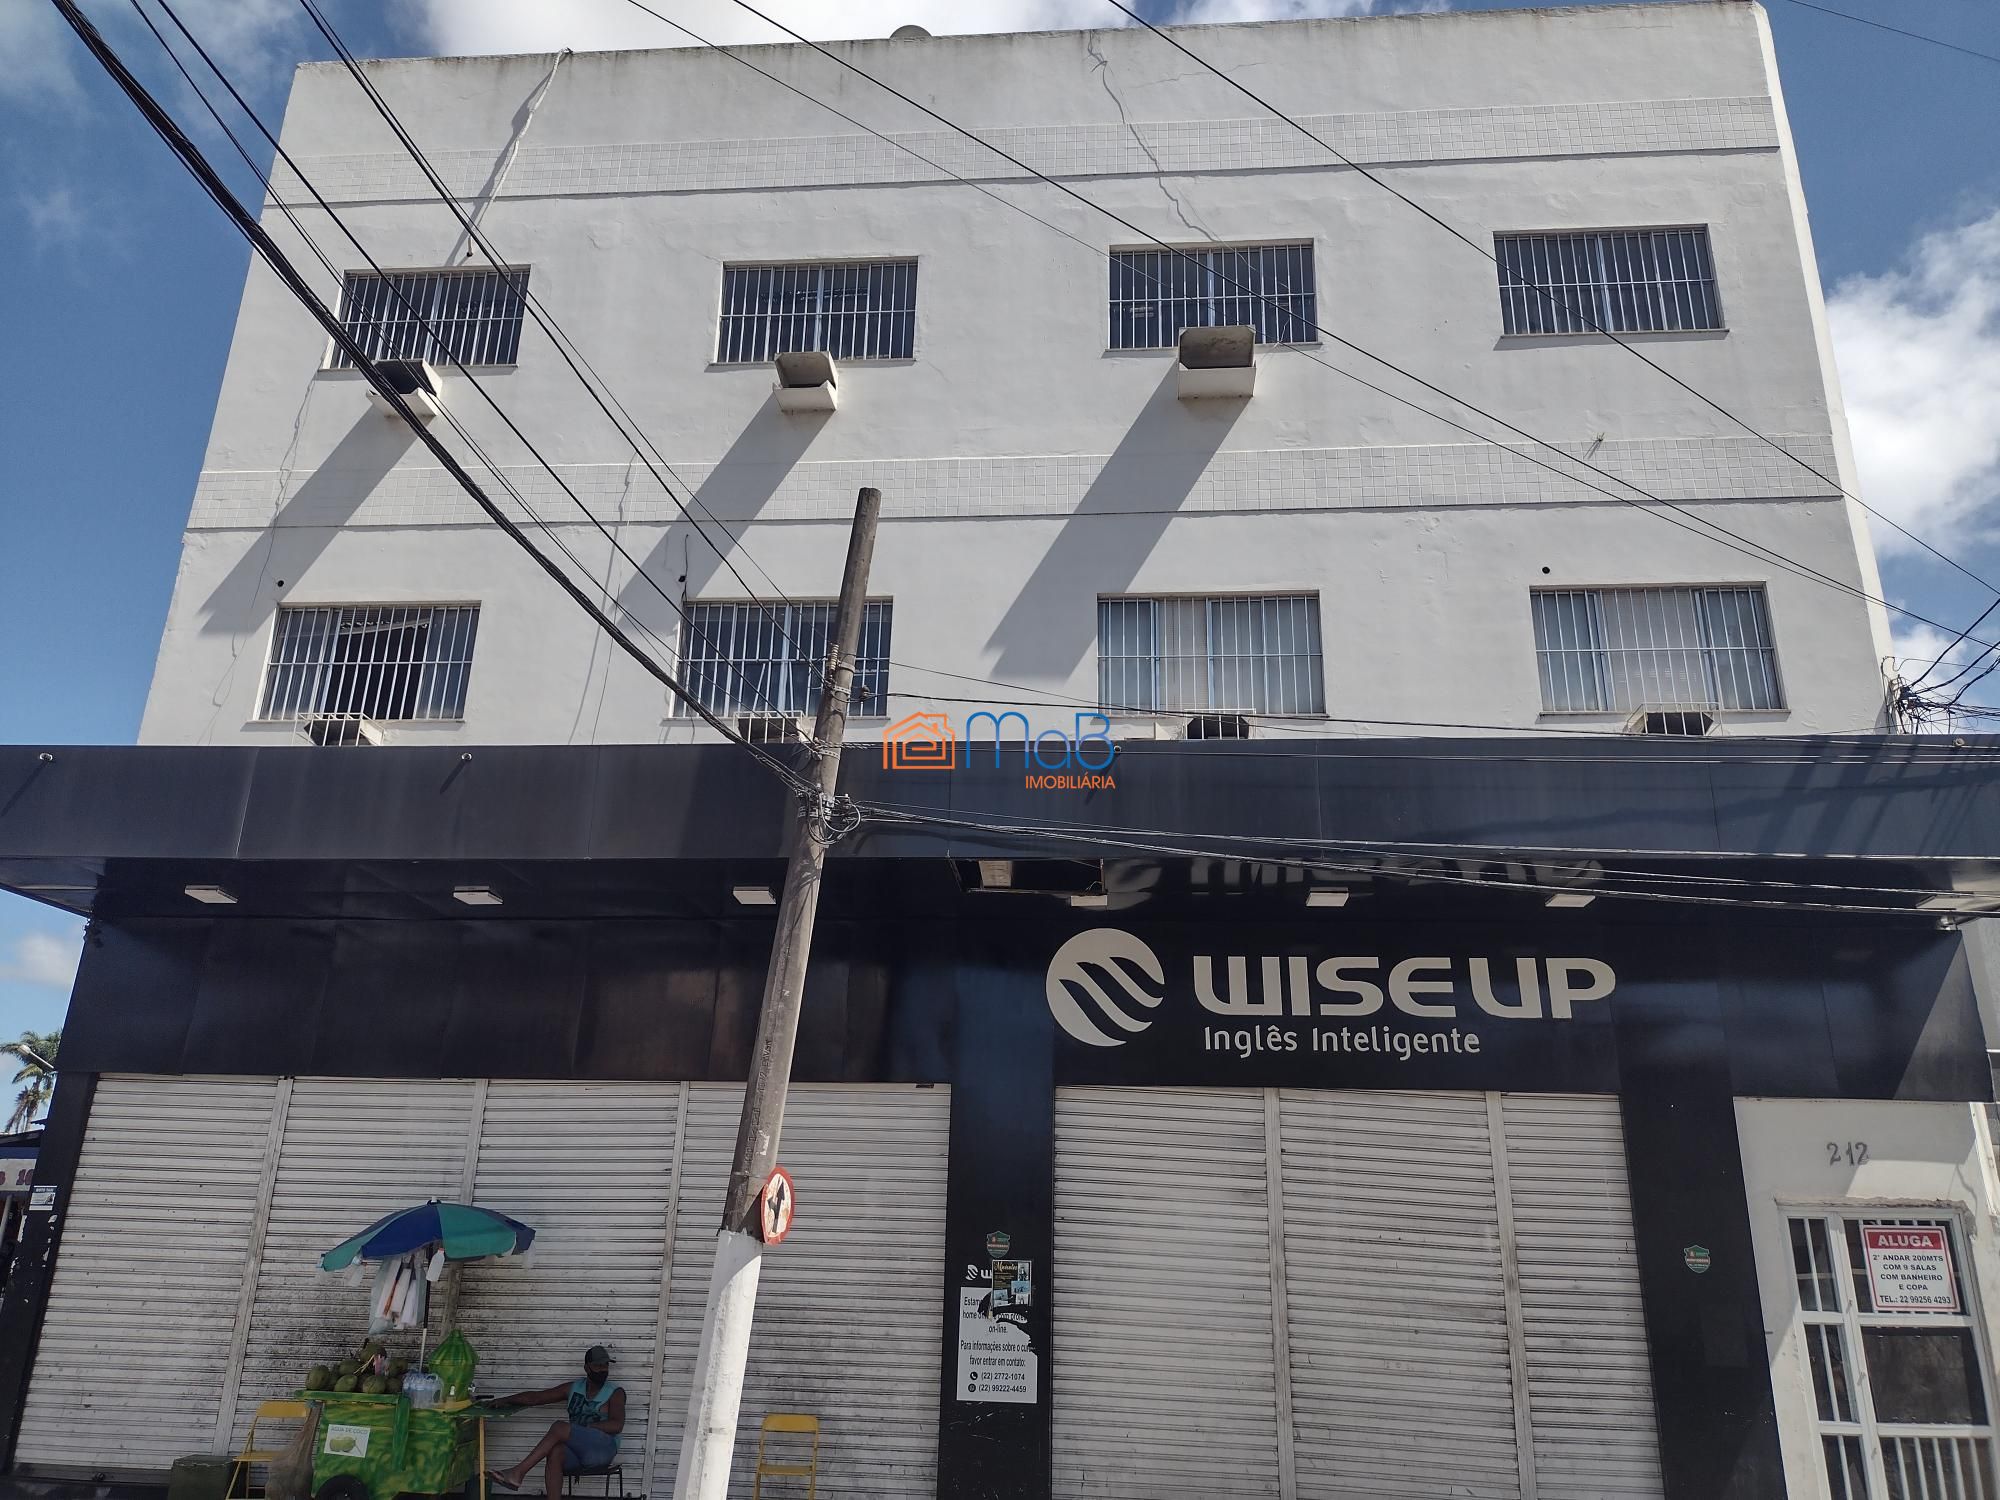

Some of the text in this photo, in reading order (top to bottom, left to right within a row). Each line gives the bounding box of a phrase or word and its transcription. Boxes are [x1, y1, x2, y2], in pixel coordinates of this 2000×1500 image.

[1204, 1025, 1481, 1061] Inglês Inteligente
[1826, 1141, 1870, 1166] 212
[1878, 1234, 1934, 1247] ALUGA
[1899, 1295, 1909, 1303] 22
[1909, 1296, 1932, 1304] 99256
[962, 1310, 977, 1320] home
[960, 1339, 972, 1350] Para
[972, 1340, 1002, 1353] informações
[1002, 1341, 1016, 1352] sobre
[1016, 1344, 1021, 1352] o
[969, 1354, 982, 1365] favor
[982, 1356, 997, 1366] entrar
[998, 1358, 1006, 1367] em
[981, 1371, 1025, 1381] (22) 2772-1074
[978, 1383, 1027, 1393] (22) 99222-4459
